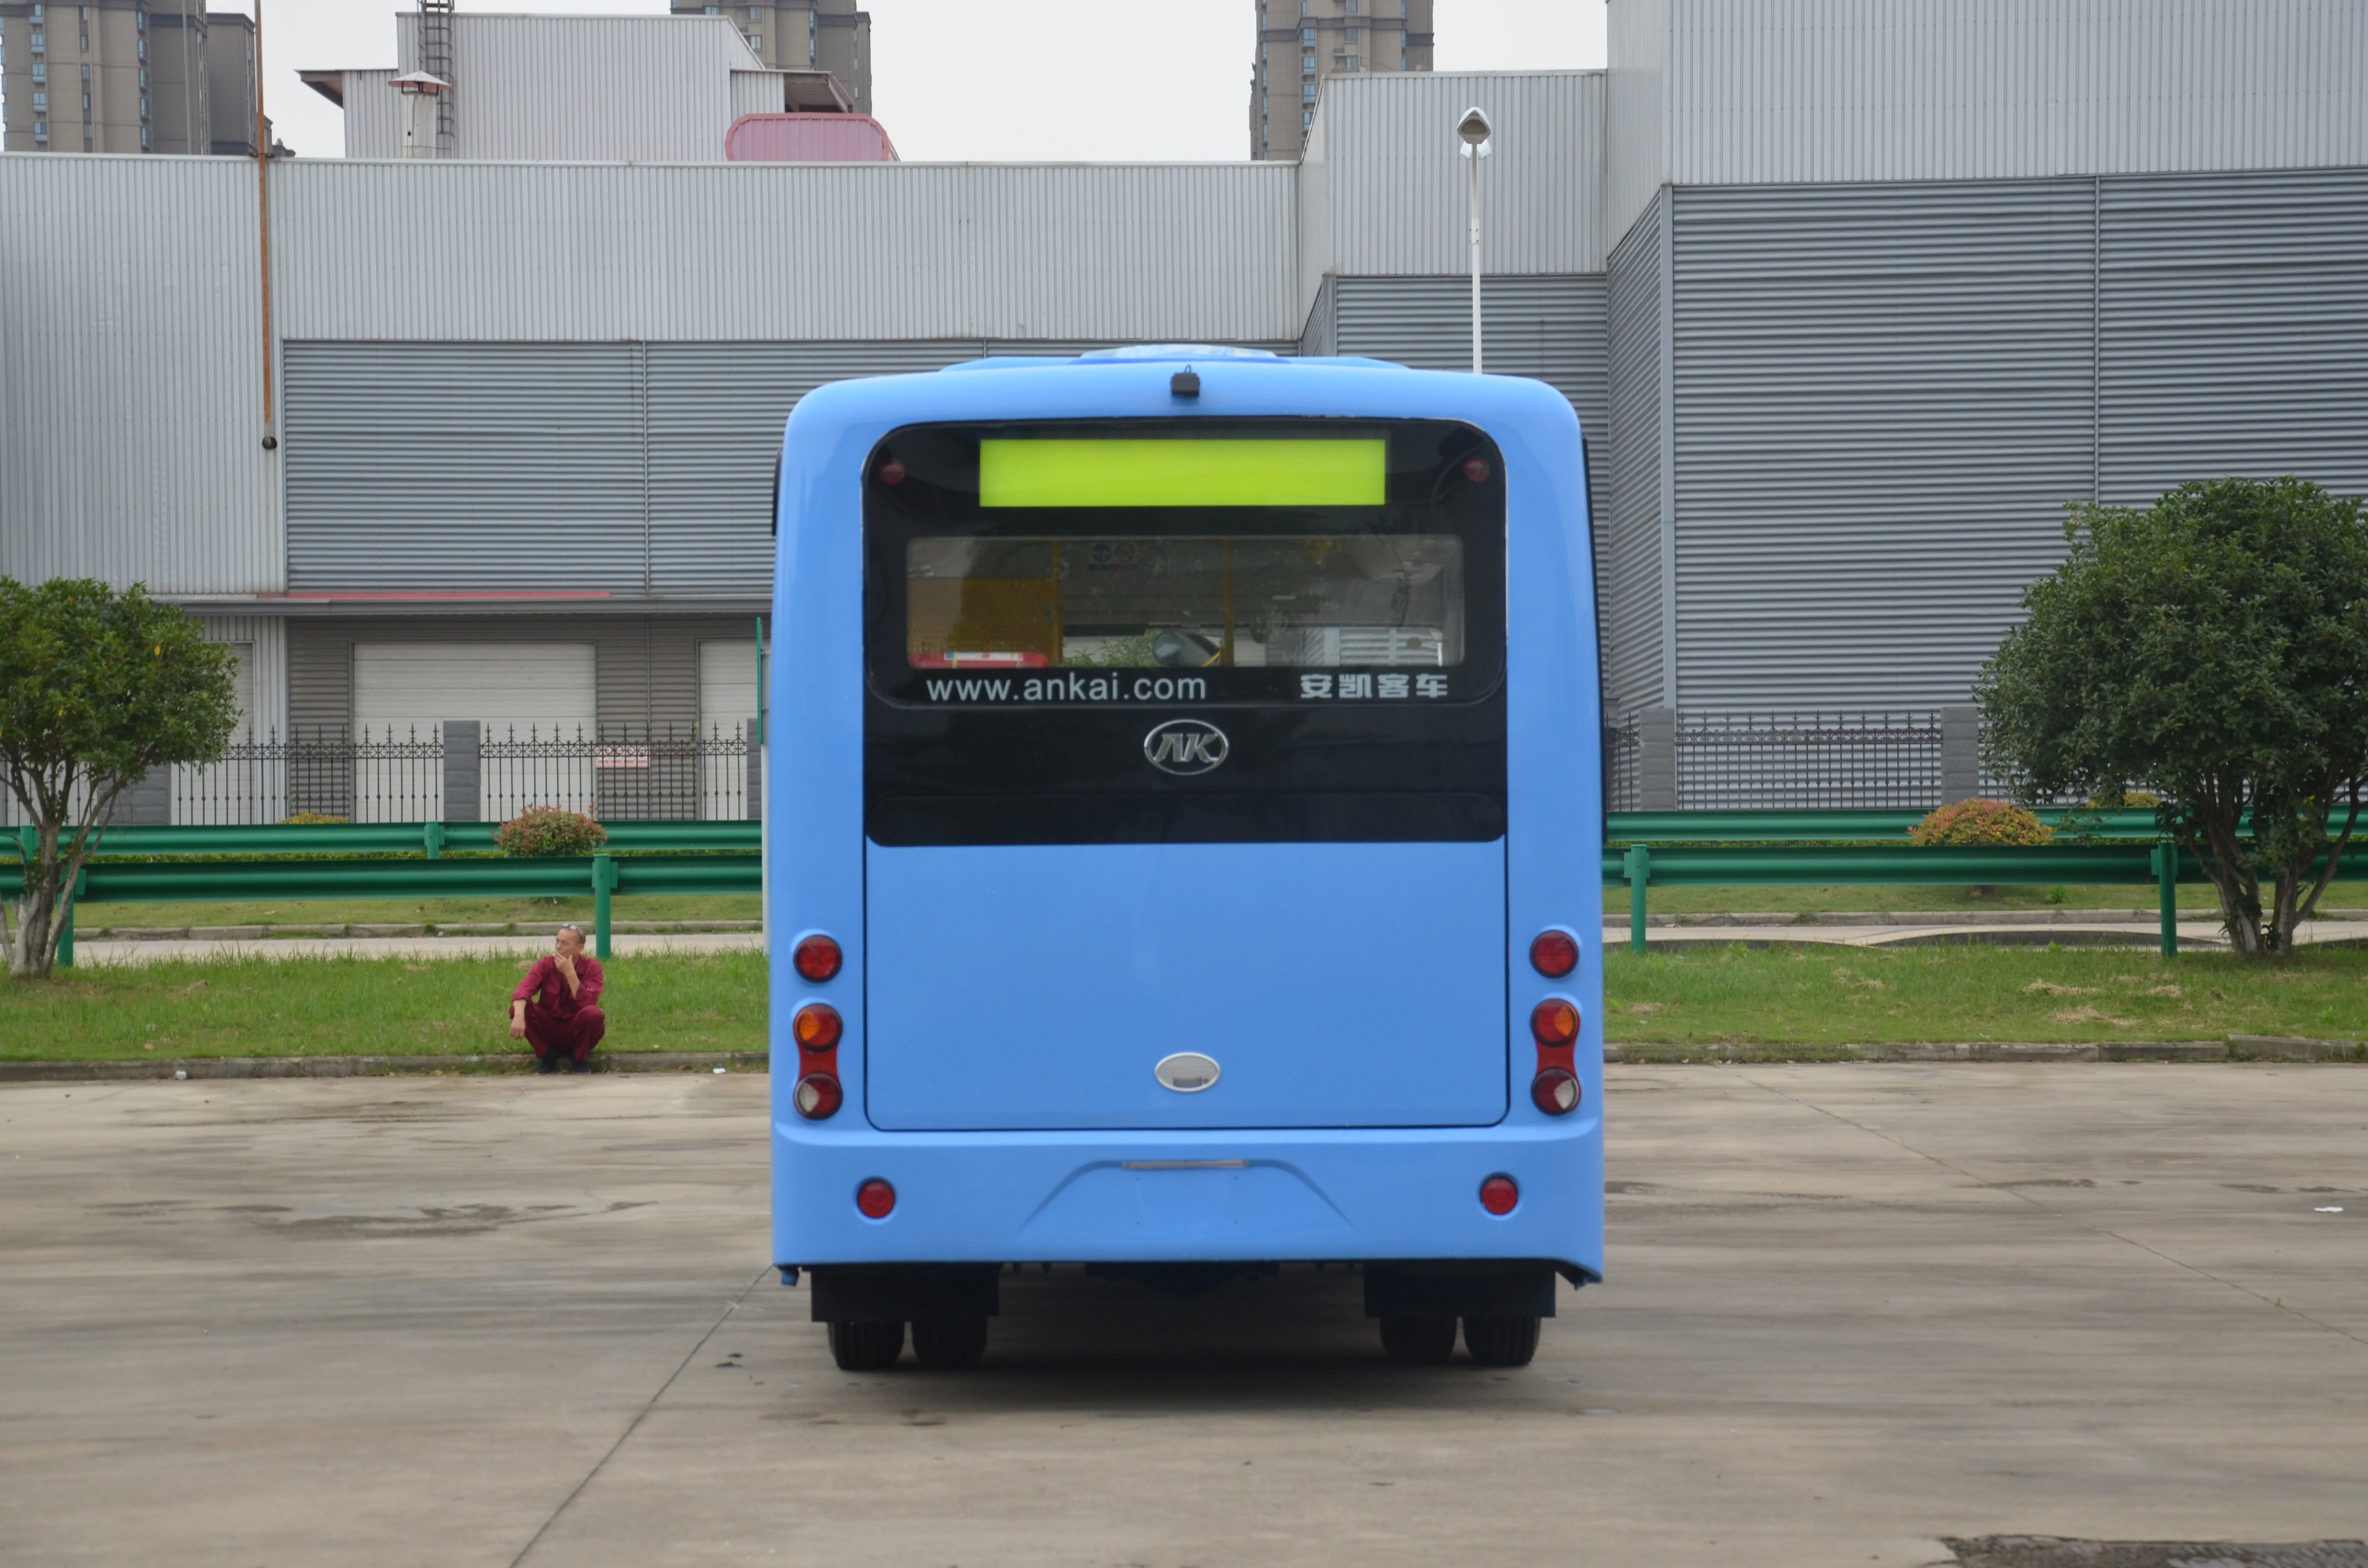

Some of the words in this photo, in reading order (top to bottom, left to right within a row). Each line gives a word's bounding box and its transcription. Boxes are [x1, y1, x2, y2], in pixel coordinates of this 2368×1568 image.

[926, 672, 1206, 700] www.ankai.com
[1300, 673, 1447, 698] 安凯客车
